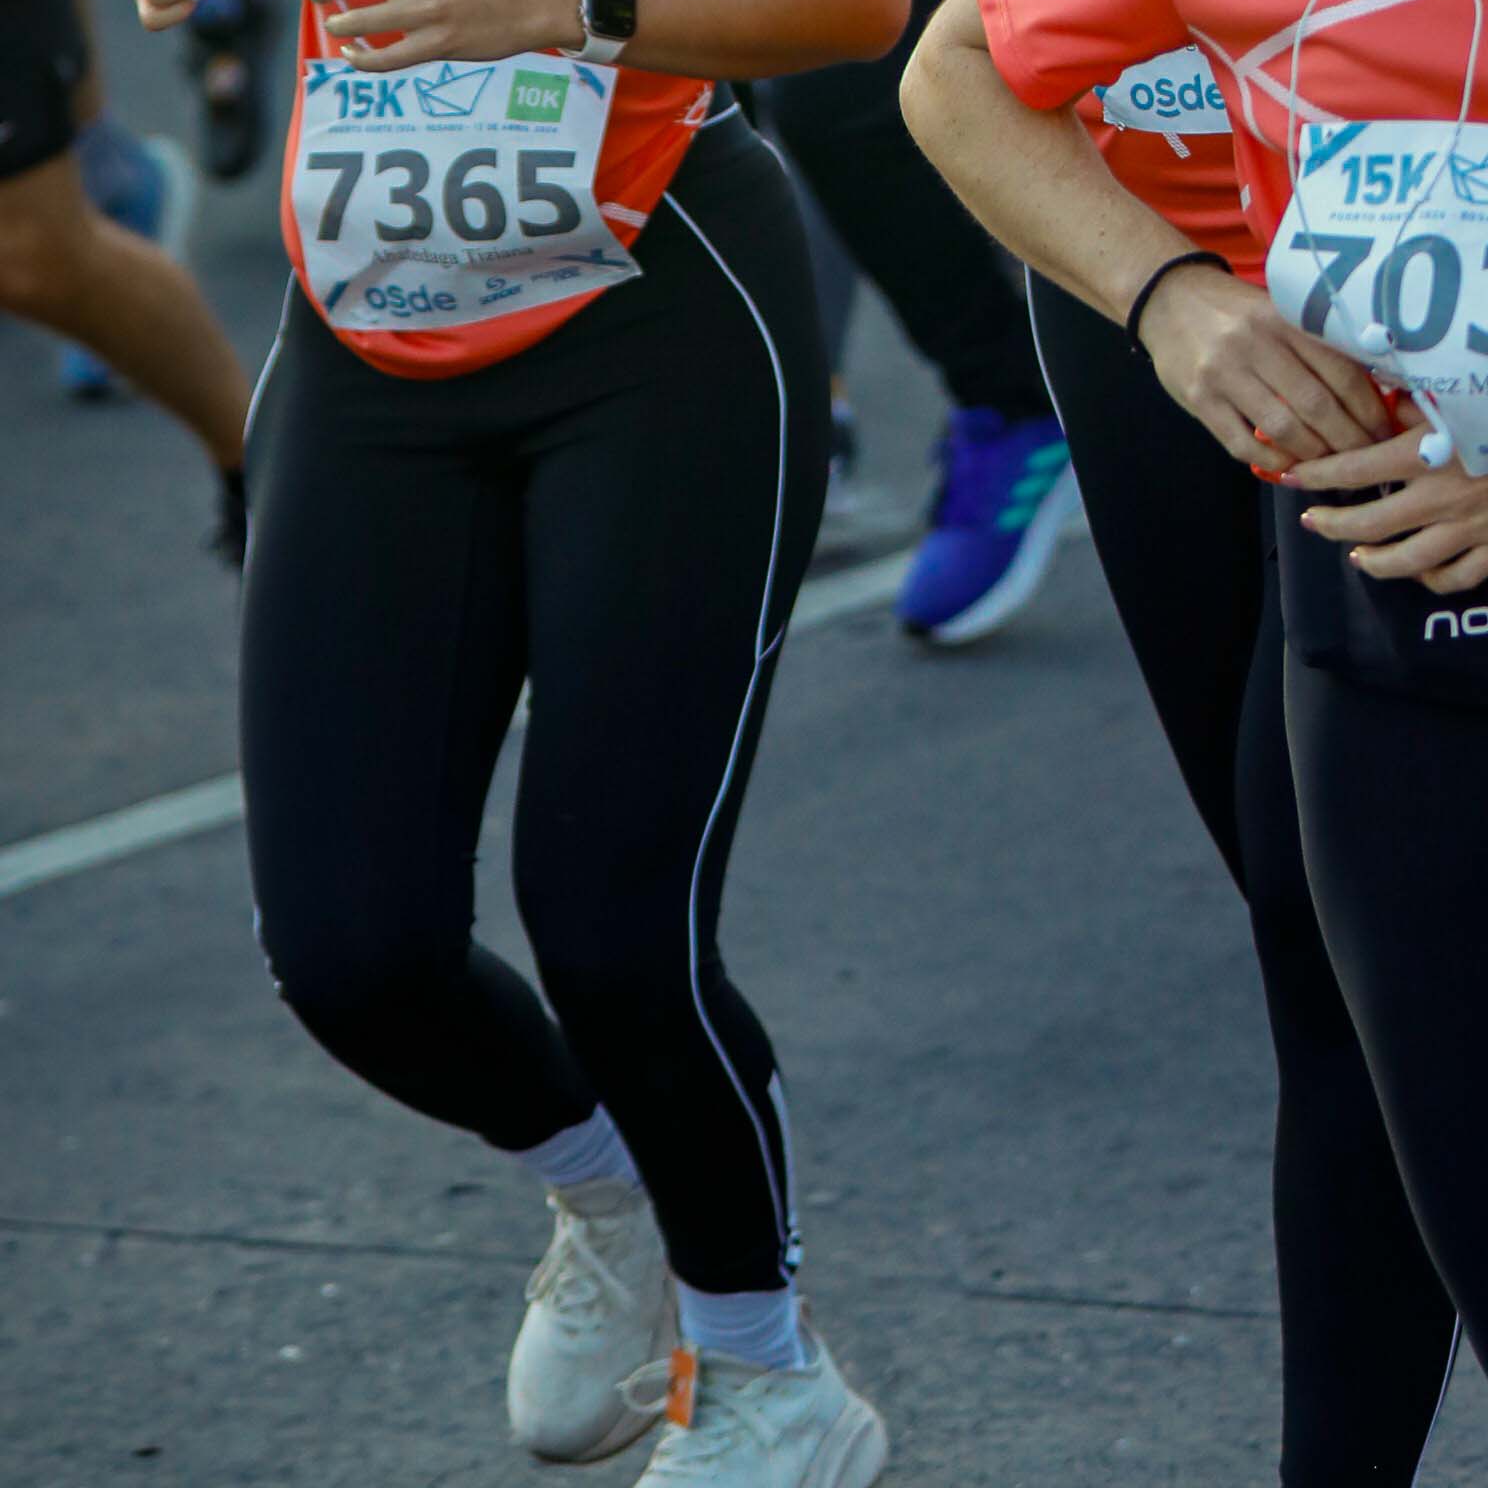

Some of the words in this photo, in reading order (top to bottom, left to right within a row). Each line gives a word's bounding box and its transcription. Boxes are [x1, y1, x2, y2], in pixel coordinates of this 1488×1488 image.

[334, 78, 408, 118] 15K
[515, 85, 560, 109] 10K
[1130, 74, 1226, 112] osde
[307, 148, 581, 242] 7365
[1341, 151, 1436, 206] 15K
[364, 280, 458, 313] osde
